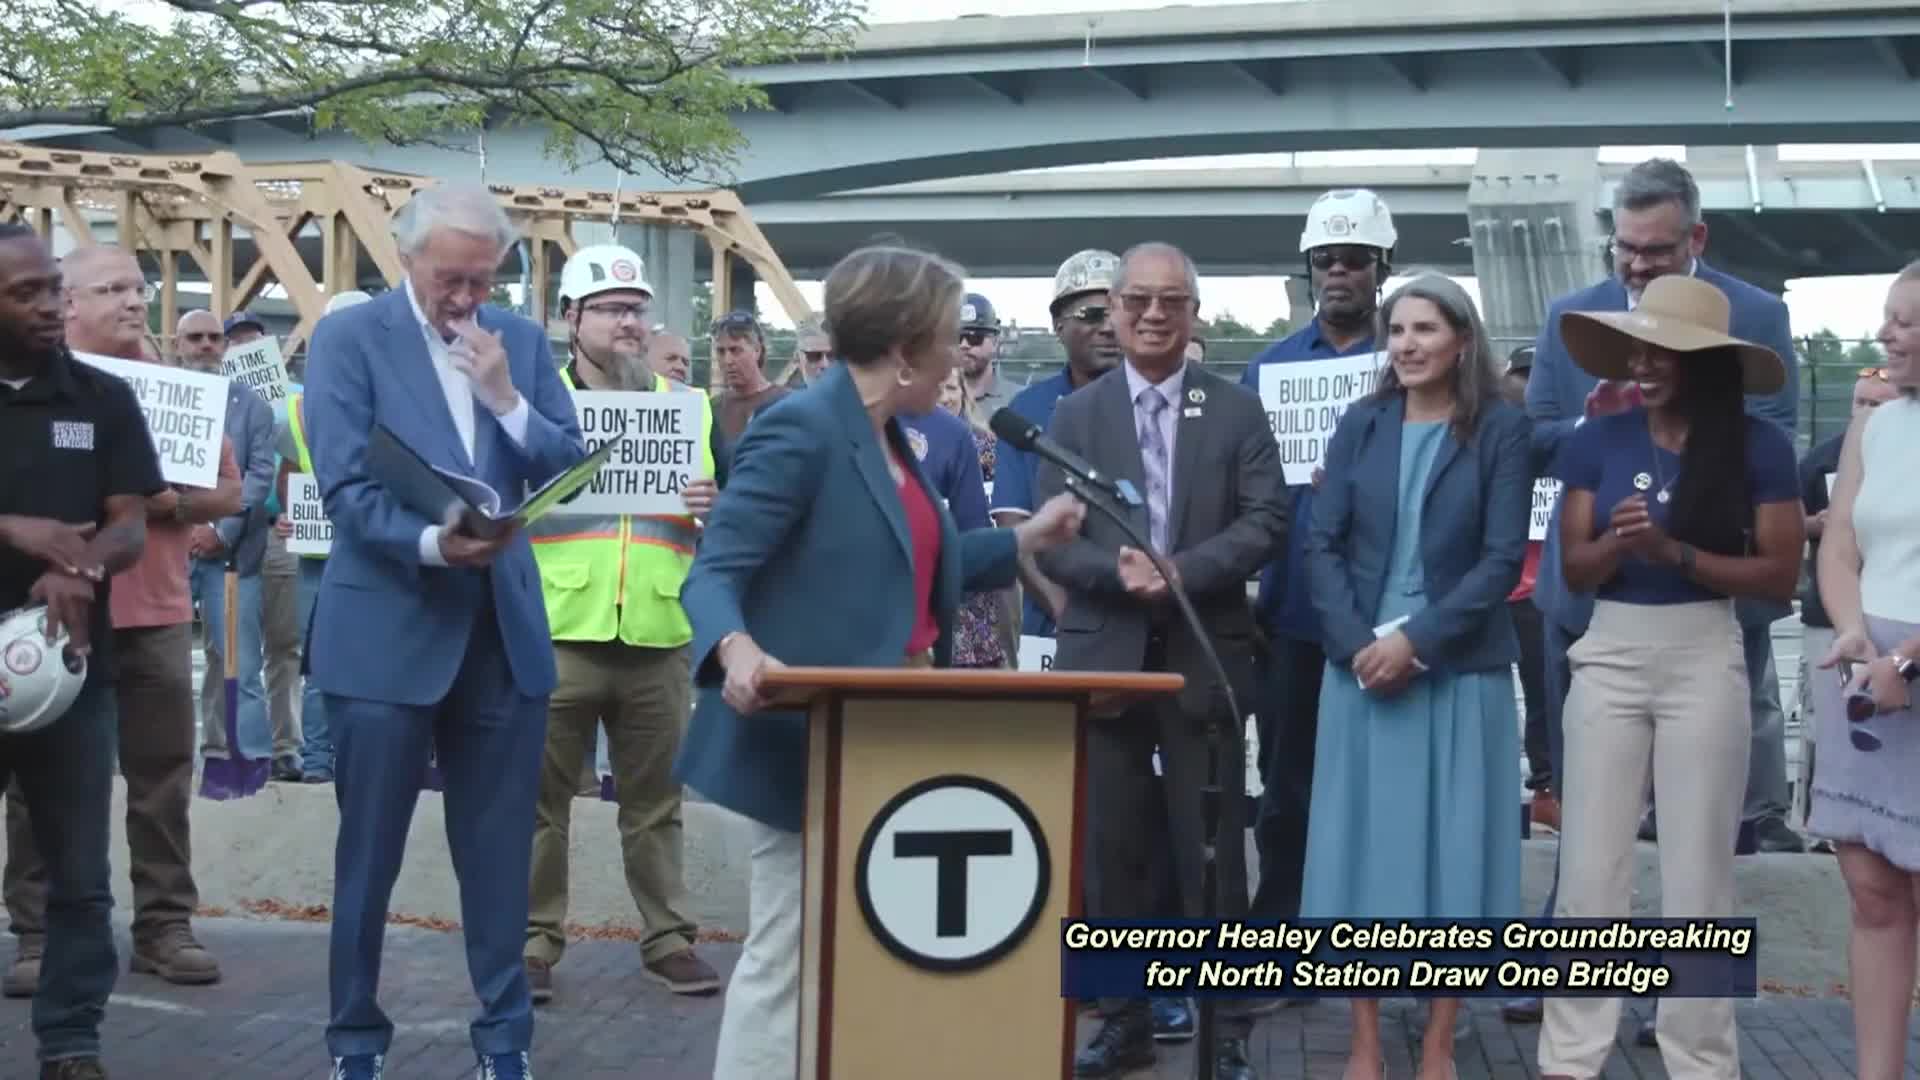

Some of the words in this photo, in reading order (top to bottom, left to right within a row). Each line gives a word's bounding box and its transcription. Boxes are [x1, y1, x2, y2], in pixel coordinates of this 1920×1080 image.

[1279, 376, 1328, 404] BUILD
[601, 407, 682, 434] ON-TIME
[1266, 406, 1316, 434] BUILD
[589, 469, 637, 495] WITH
[293, 503, 328, 521] BUIL
[296, 523, 334, 541] BUILD
[893, 829, 1013, 938] T
